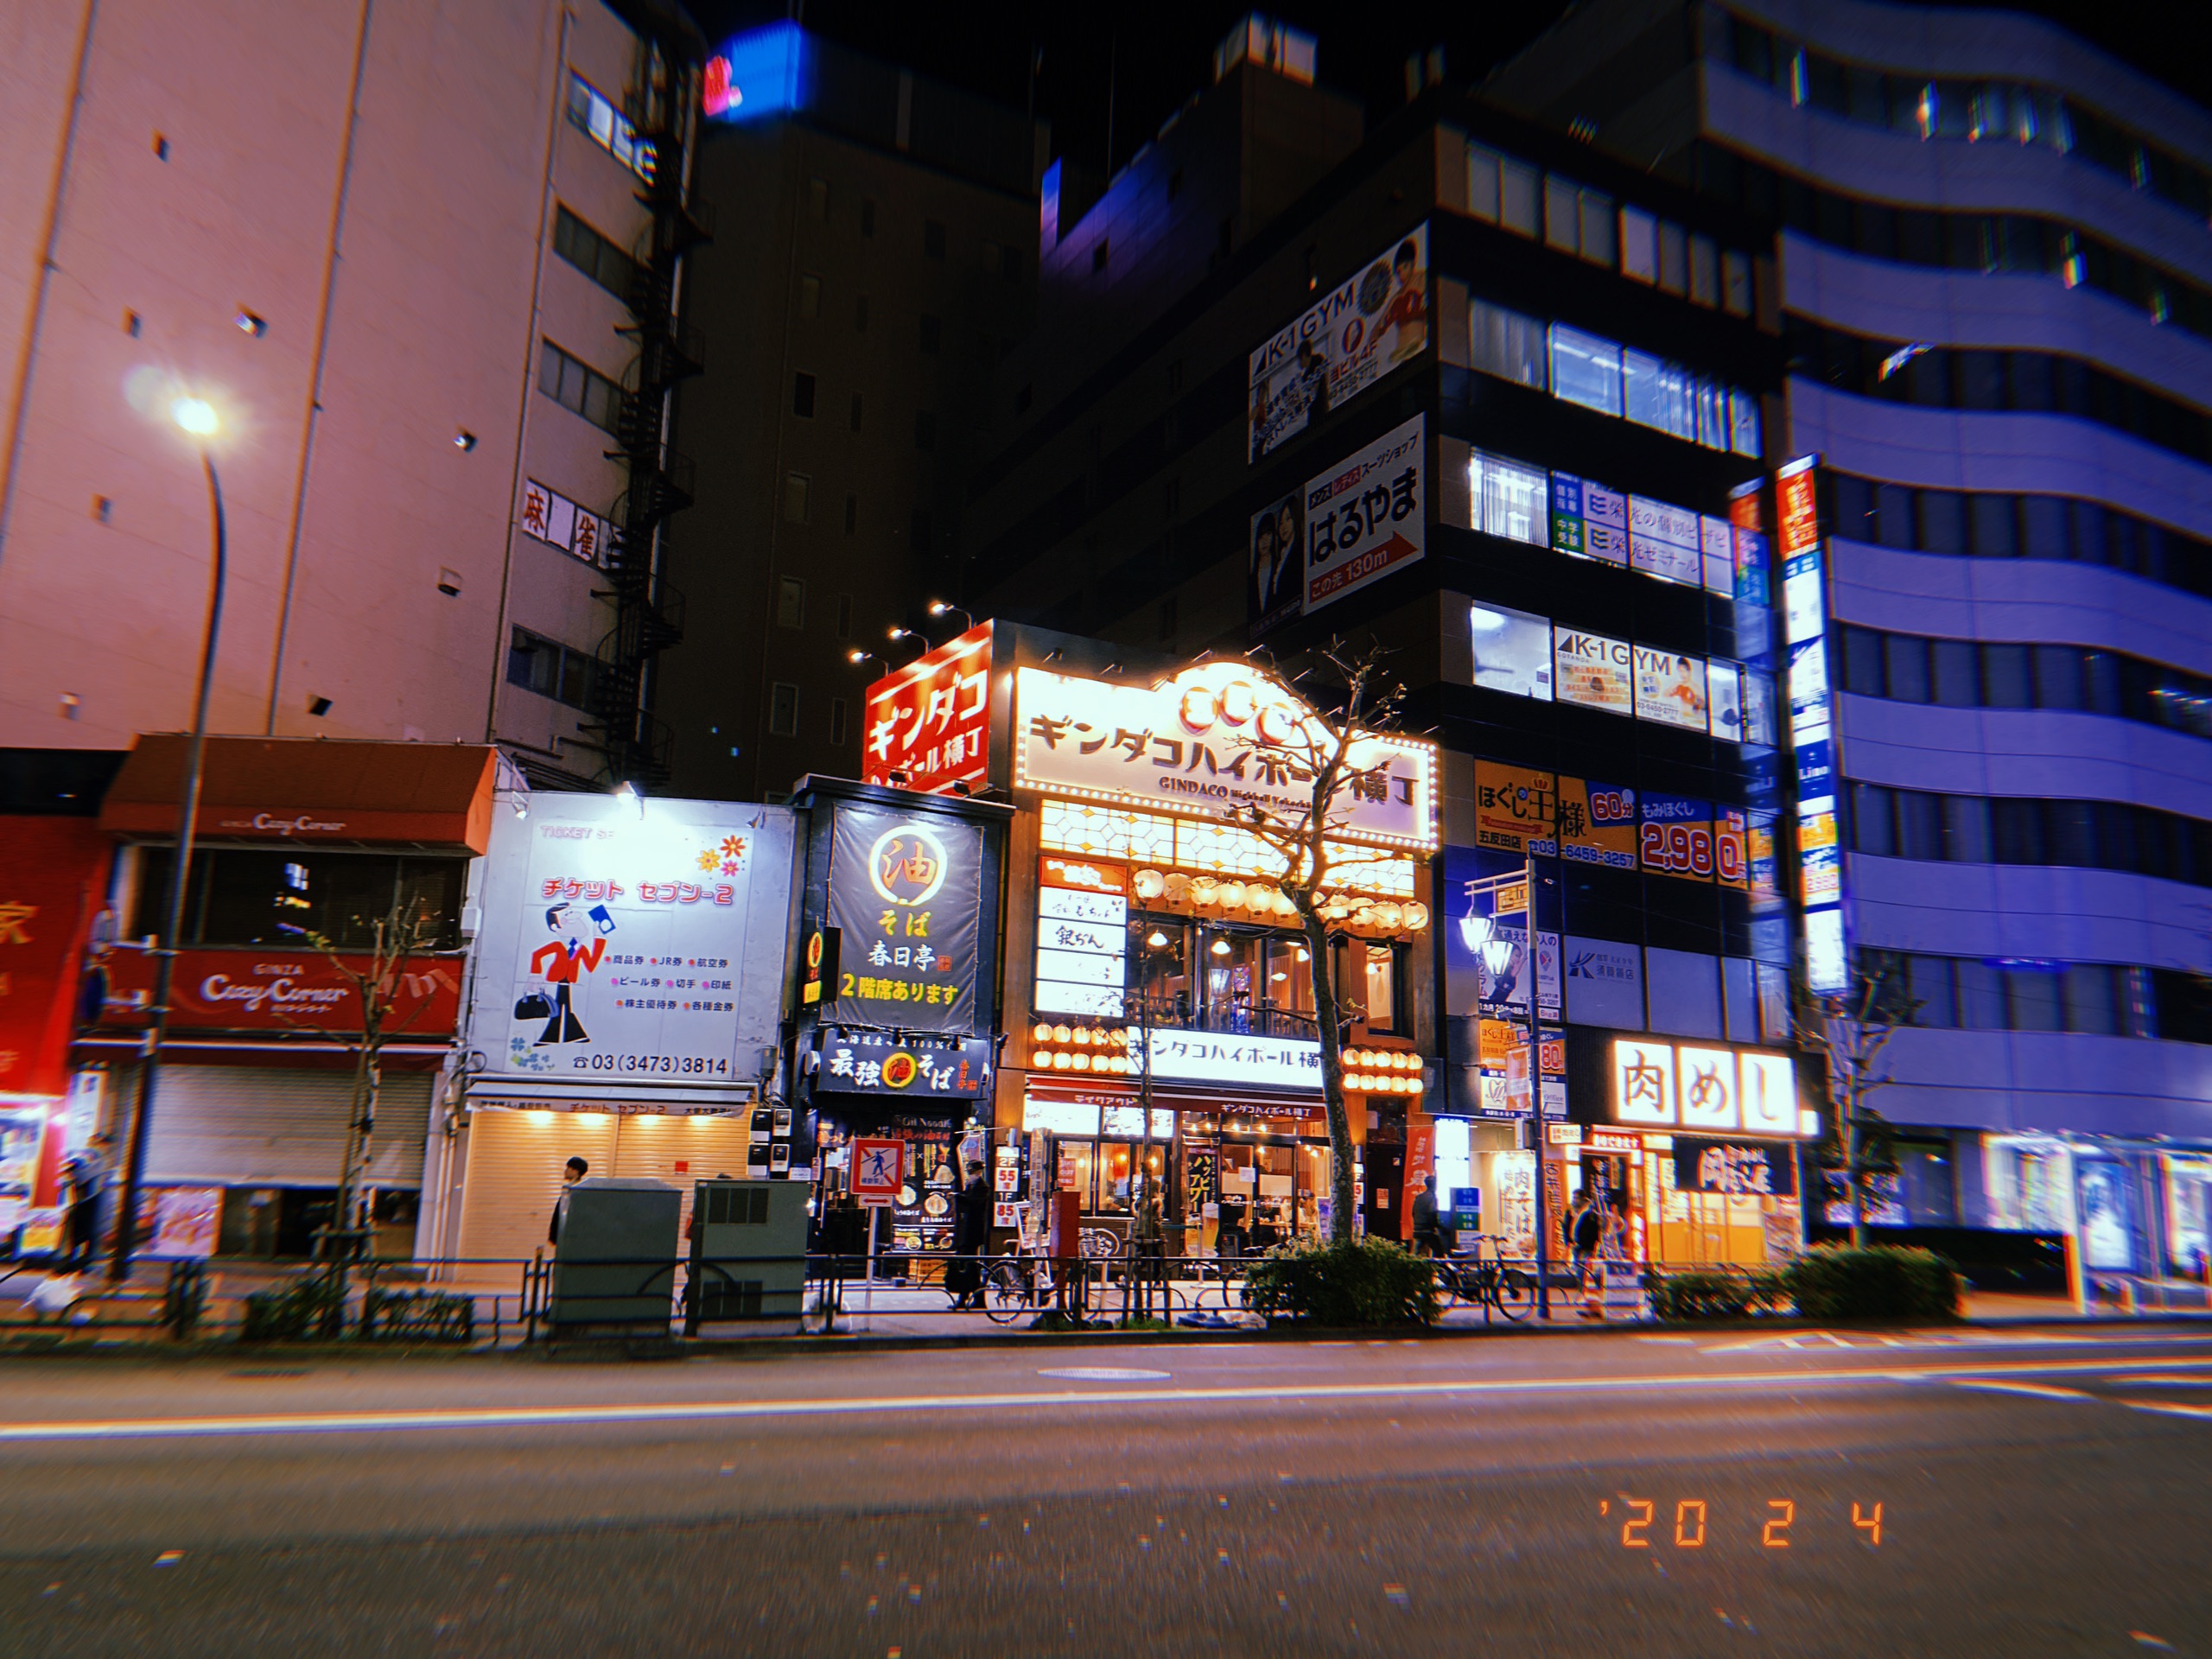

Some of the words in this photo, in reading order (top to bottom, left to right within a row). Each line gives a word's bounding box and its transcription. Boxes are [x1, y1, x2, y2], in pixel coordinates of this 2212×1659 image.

[1300, 282, 1355, 338] GYM
[1310, 467, 1417, 567] はるやま
[1556, 518, 1578, 533] 中学
[1312, 573, 1343, 597] この先
[1346, 549, 1388, 582] 130m
[1611, 645, 1671, 677] GYM
[868, 669, 988, 760] ギンダコ
[1030, 714, 1420, 807] ギンダコハイボー横丁
[1160, 777, 1229, 798] GINDACO
[1478, 782, 1586, 838] ほぐしの王様
[1591, 792, 1634, 820] 60分
[1642, 802, 1694, 818] もみほぐし
[541, 825, 592, 839] TICKET
[1479, 830, 1522, 849] 五反田店
[881, 838, 936, 888] 油
[542, 877, 624, 901] チケット
[638, 881, 734, 905] セブン-2
[878, 909, 931, 937] そば
[613, 955, 645, 965] 商品券
[658, 957, 683, 967] JR券
[696, 957, 728, 969] 航空券
[868, 940, 936, 972] 春日亭
[200, 974, 264, 1012] Cozy
[269, 977, 350, 1002] Corner
[620, 977, 661, 988] ビール券
[676, 978, 696, 988] 切手
[710, 980, 732, 990] 印紙
[841, 973, 958, 1005] 2階席あります
[625, 999, 677, 1010] 株主優待券
[692, 1001, 734, 1012] 各種金券
[592, 1055, 728, 1074] 03(3473)3814
[1623, 1049, 1779, 1122] 肉めし
[569, 1102, 611, 1113] チケット
[1075, 1094, 1135, 1106] テイクアウト
[1221, 1103, 1312, 1117] ギンダコハイボール横丁
[1000, 1158, 1016, 1166] 2F
[998, 1170, 1015, 1181] 55
[999, 1192, 1013, 1201] 1F
[996, 1205, 1014, 1217] 85
